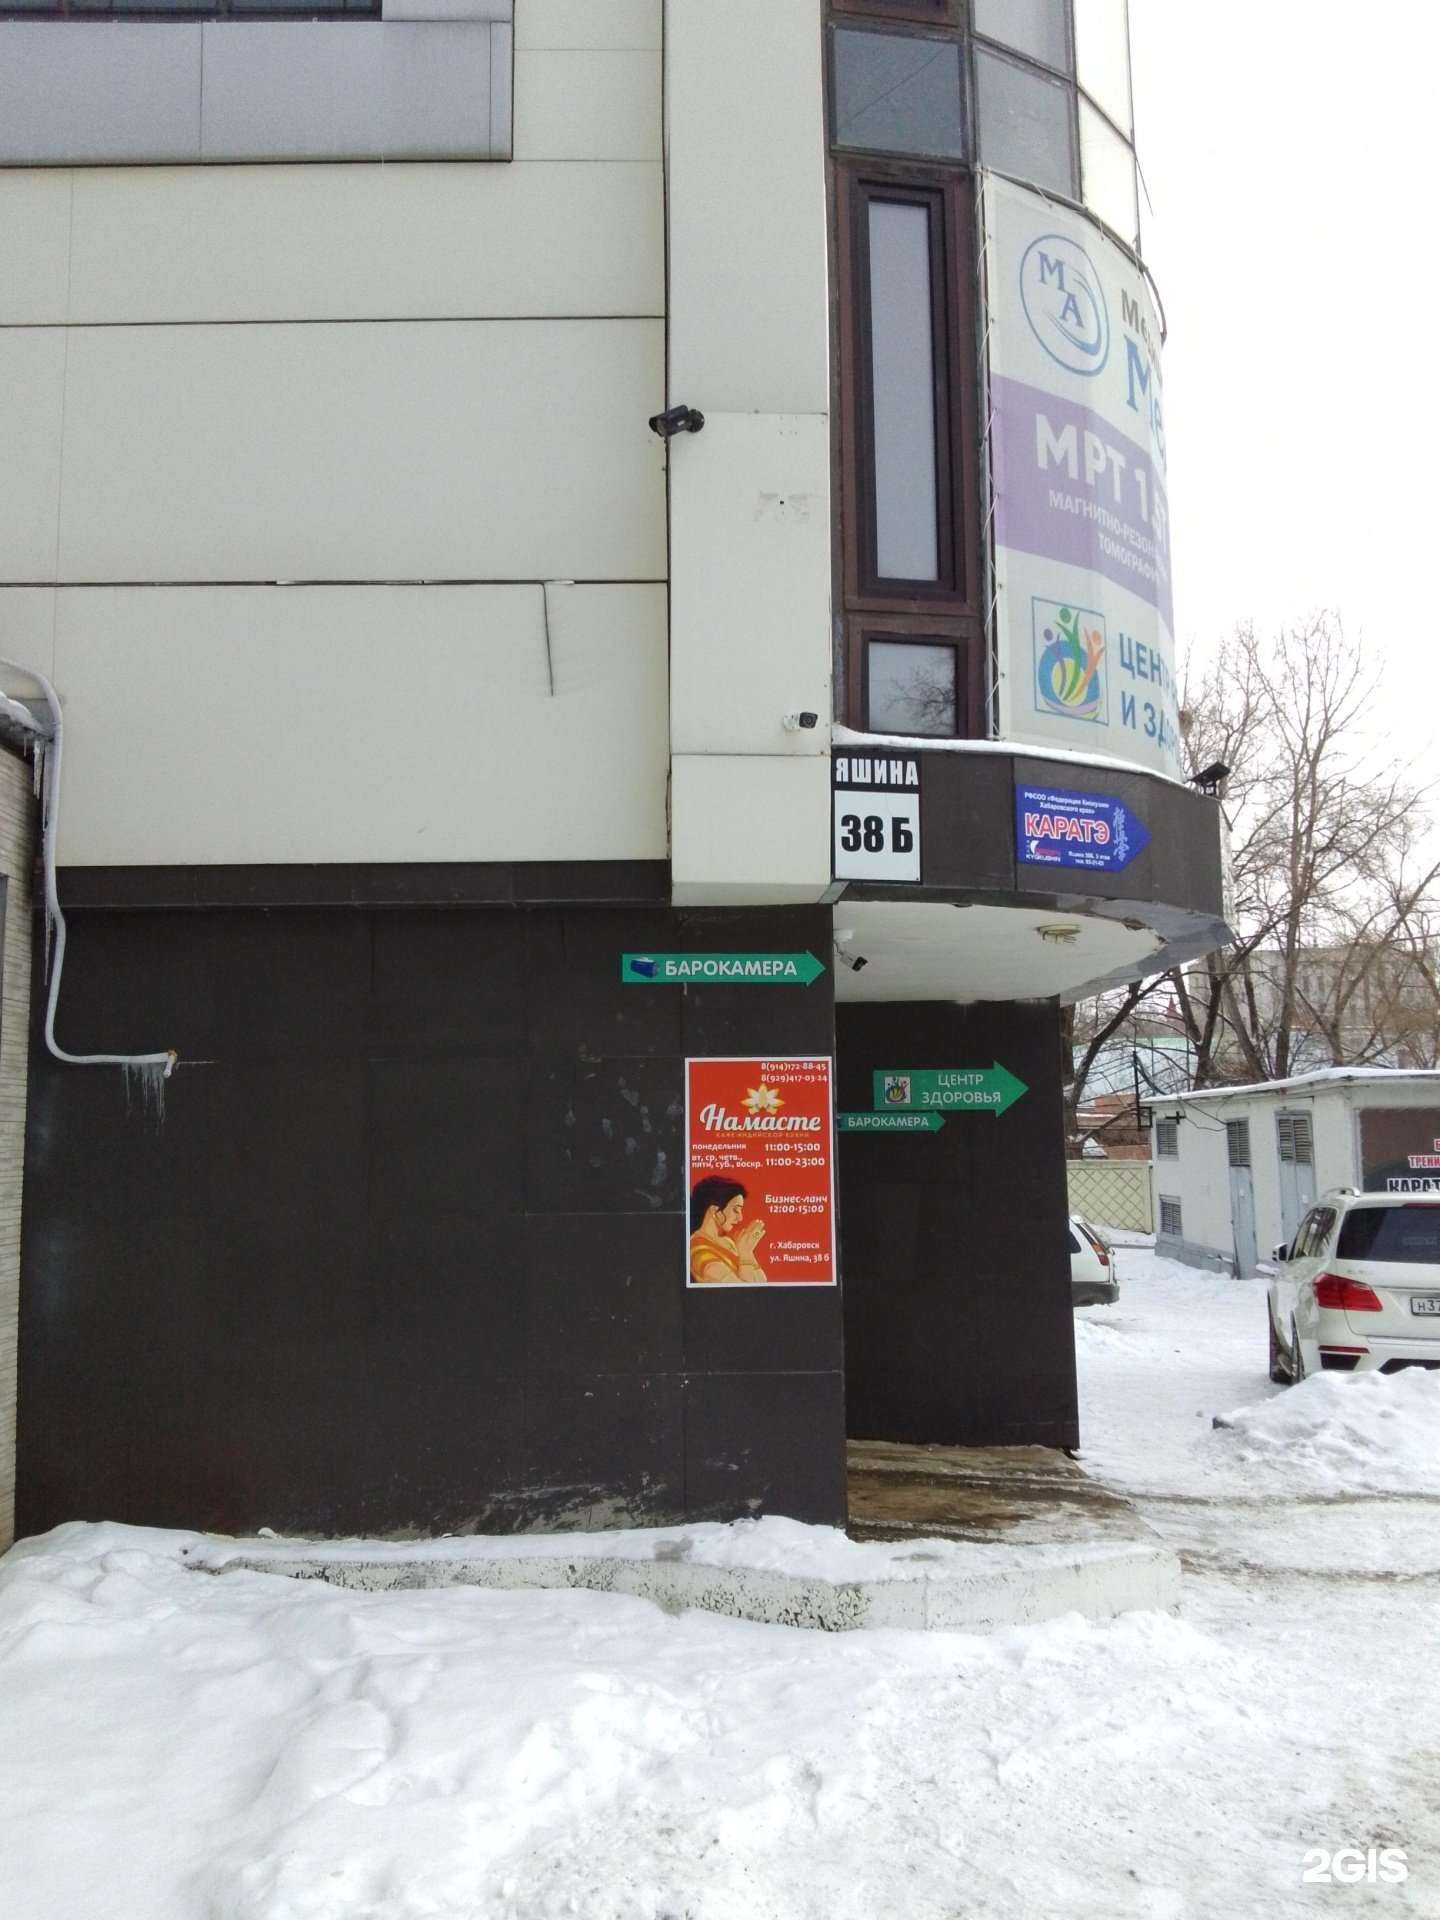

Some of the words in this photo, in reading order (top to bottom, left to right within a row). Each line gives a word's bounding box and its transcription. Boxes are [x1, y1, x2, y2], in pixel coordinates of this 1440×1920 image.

[1036, 413, 1126, 504] МРТ
[1121, 690, 1136, 730] И
[836, 757, 919, 785] ЯШИНА
[841, 814, 885, 853] 38
[891, 816, 914, 853] Б
[1024, 812, 1110, 845] КАРАТЭ
[664, 960, 797, 976] БАРОКАМЕРА
[938, 1074, 984, 1087] ЦЕНТР
[922, 1092, 1001, 1105] ЗДОРОВЬЯ
[700, 1103, 822, 1132] Намасте
[848, 1116, 929, 1127] БАРОКАМЕРА
[692, 1143, 747, 1151] понедельник
[764, 1143, 820, 1153] 11:00-15:00
[766, 1157, 825, 1167] 11:00-23:00
[765, 1194, 828, 1204] Бизнес-ланч
[769, 1205, 824, 1214] 12:00-15:00
[777, 1241, 819, 1250] Хабаровск
[769, 1255, 781, 1263] ул.
